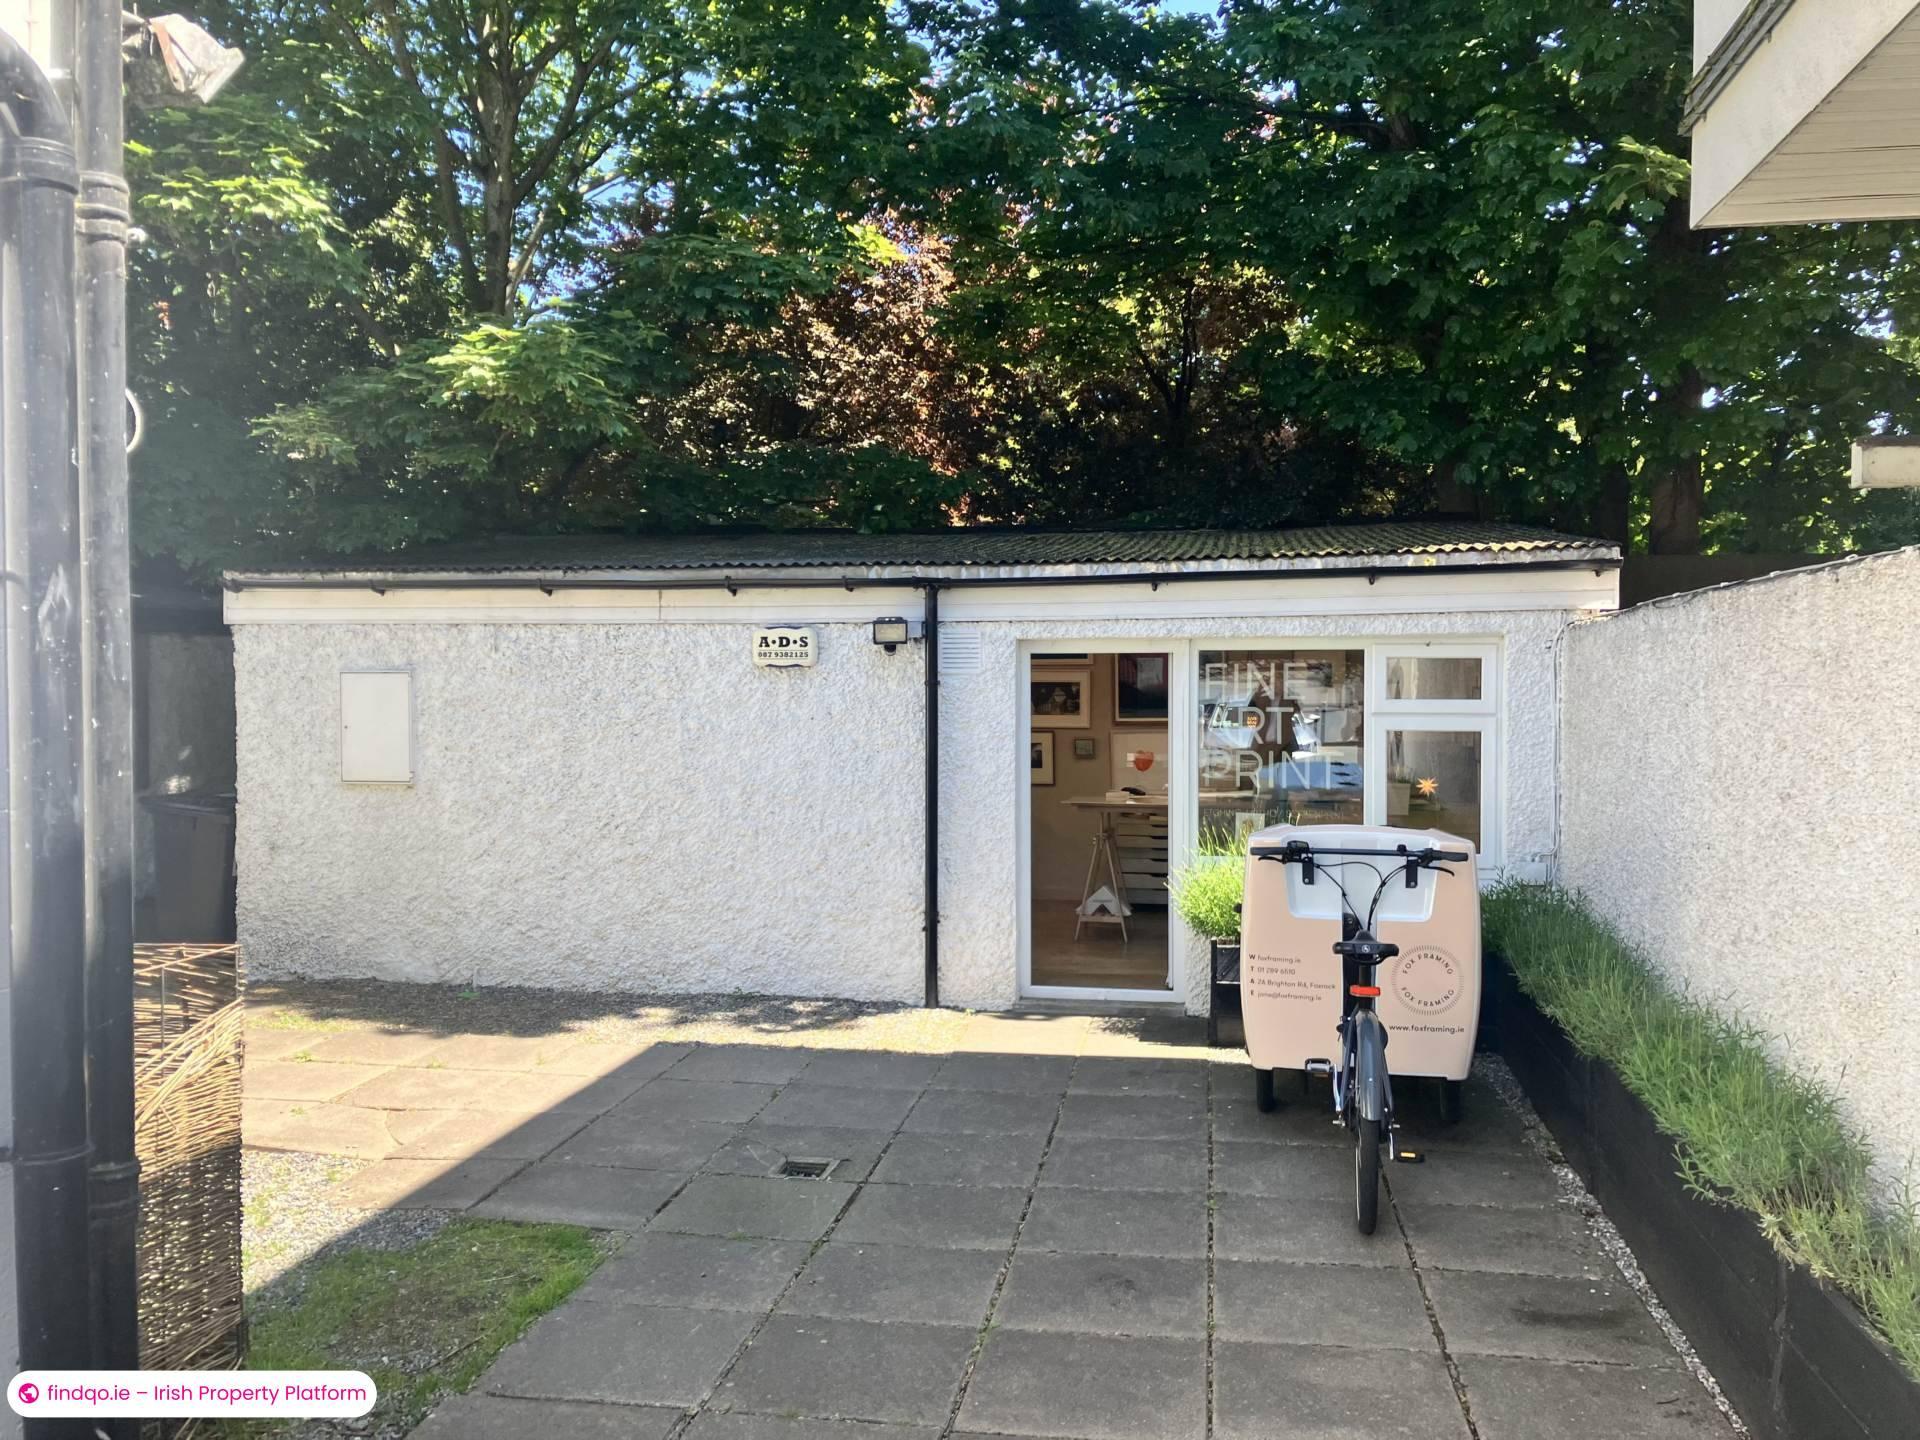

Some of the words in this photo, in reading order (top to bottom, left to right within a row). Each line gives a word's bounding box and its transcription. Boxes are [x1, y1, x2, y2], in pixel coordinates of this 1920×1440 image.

[1205, 662, 1307, 700] FINE
[1204, 750, 1345, 790] PRINT
[1402, 958, 1416, 974] FOX
[1417, 952, 1454, 975] FRAMING
[1267, 979, 1296, 989] Brighton
[1401, 986, 1416, 1002] FOX
[1417, 988, 1455, 1007] FRAMING
[1389, 1024, 1465, 1035] www.foxframing.ie
